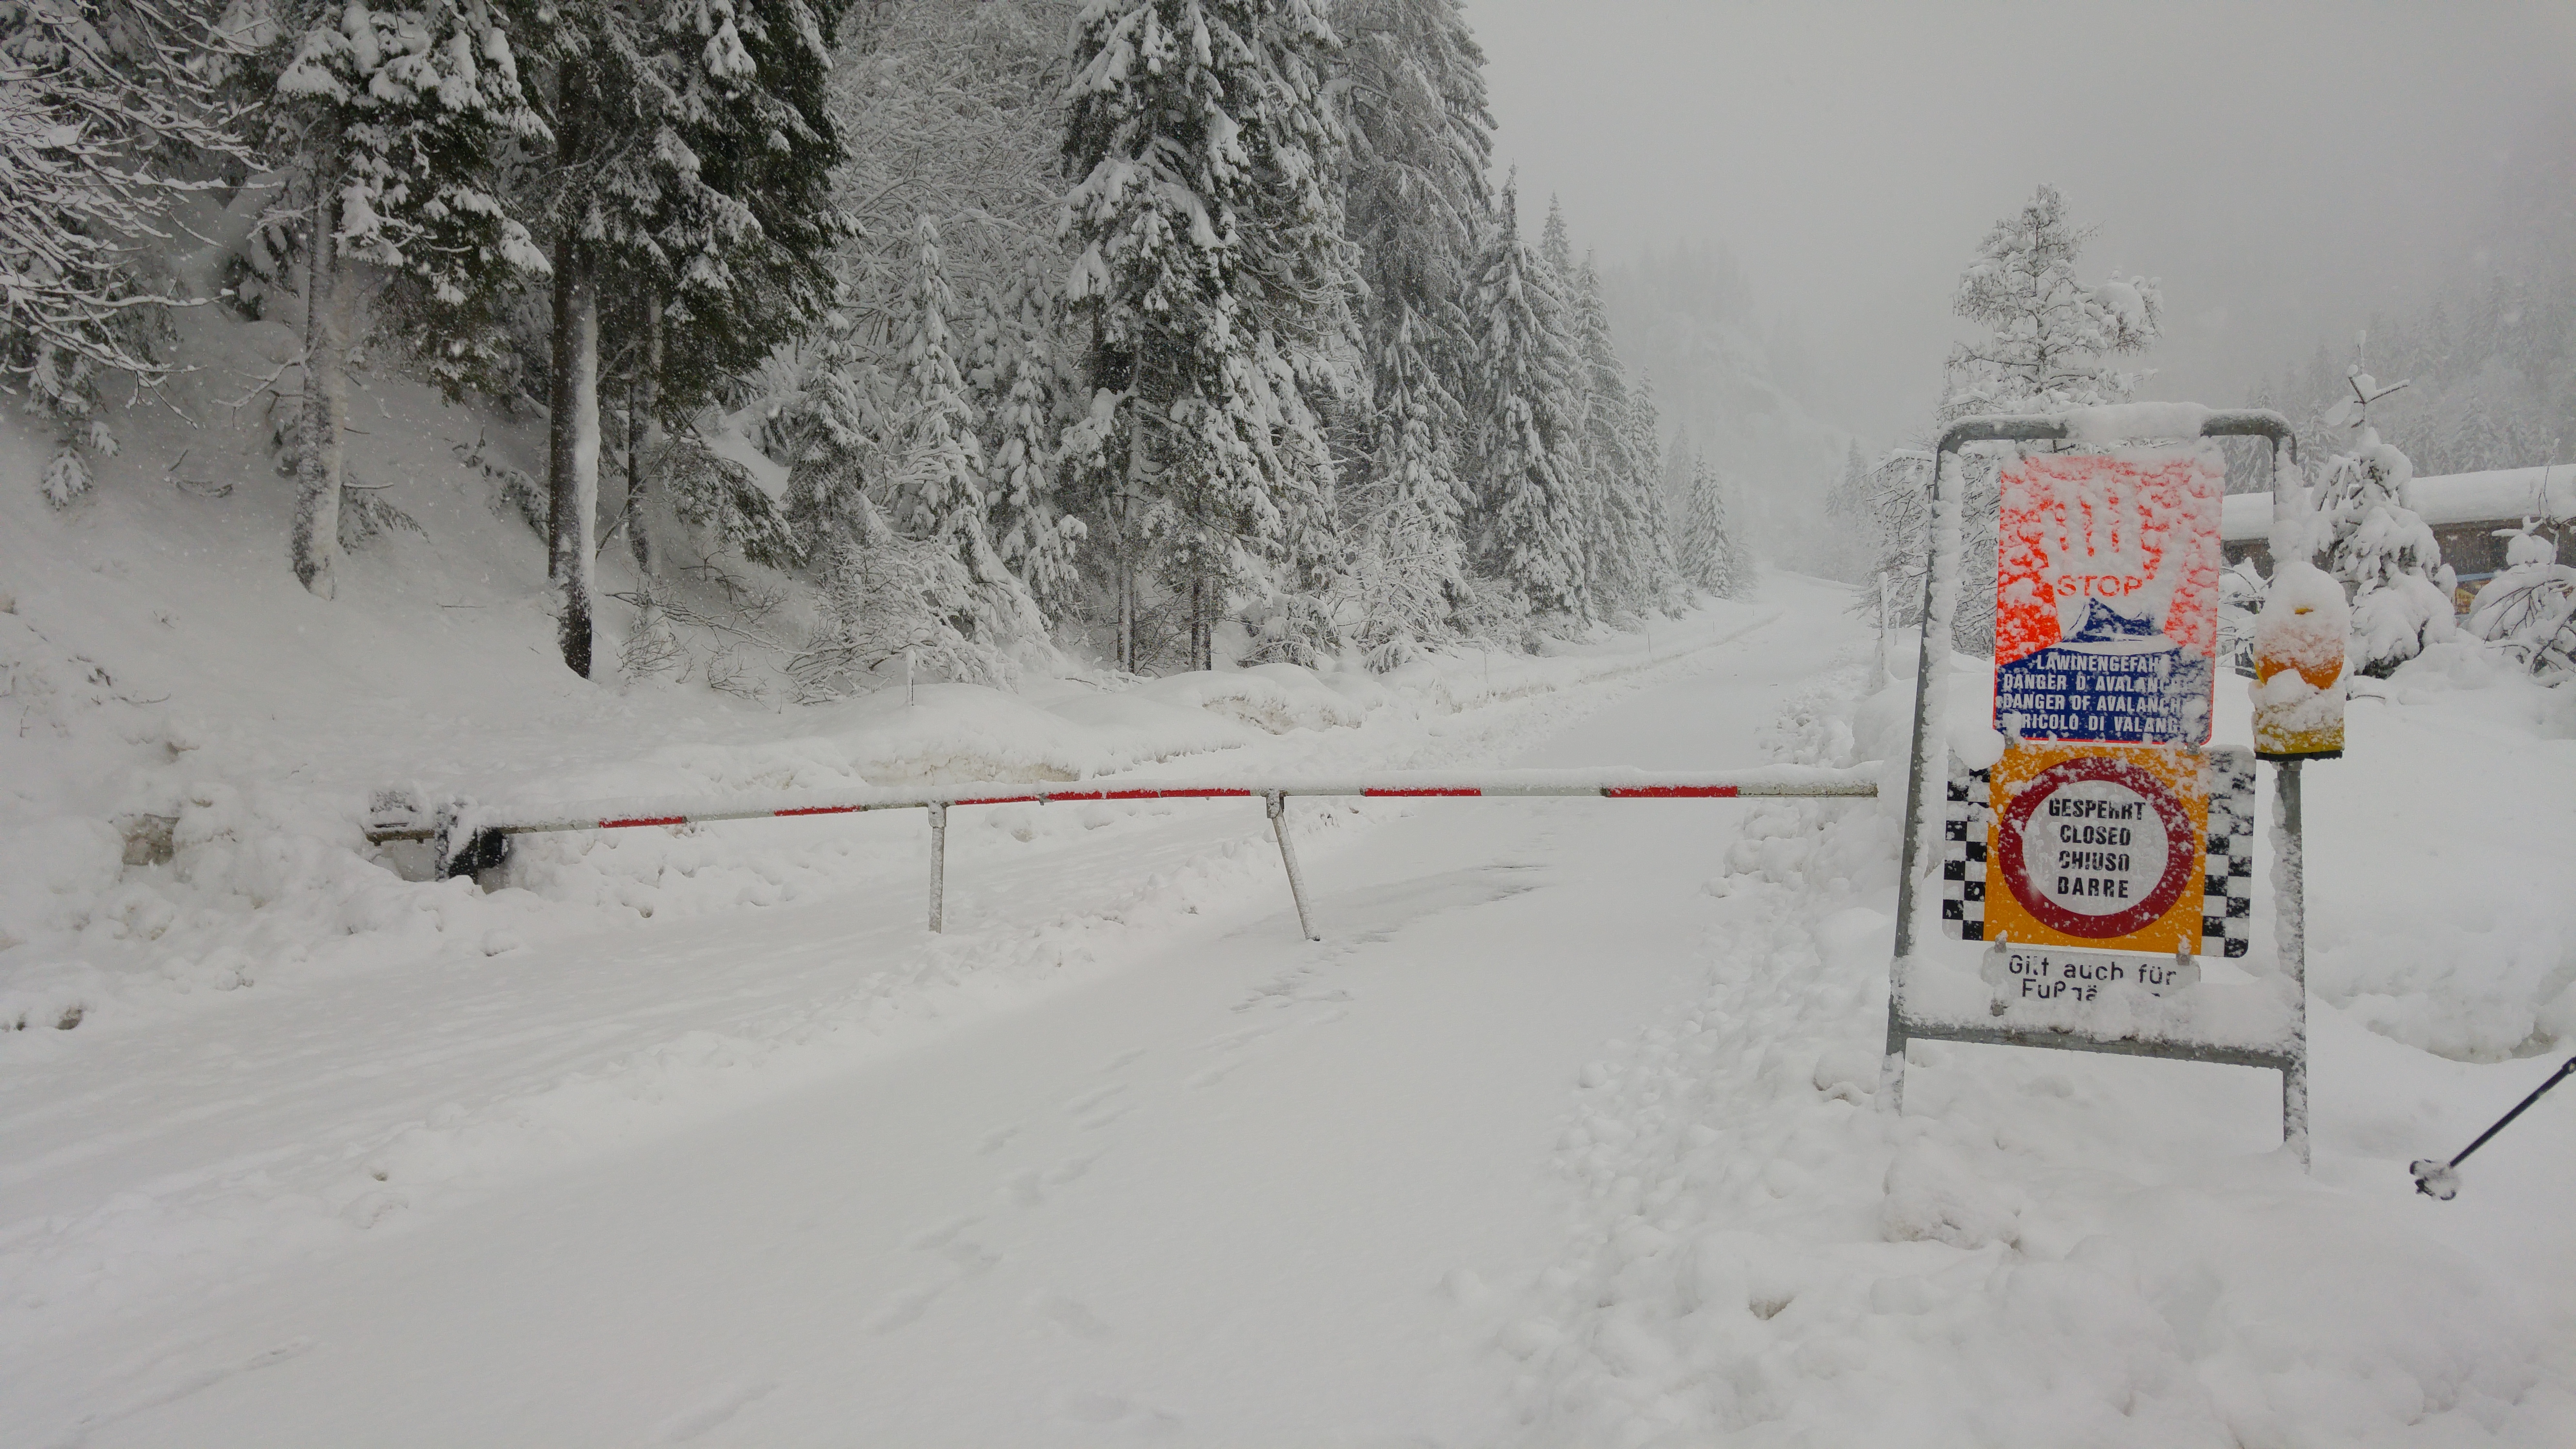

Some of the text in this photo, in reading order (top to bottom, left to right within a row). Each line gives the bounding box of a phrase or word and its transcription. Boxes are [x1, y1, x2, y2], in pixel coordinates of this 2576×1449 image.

[2056, 575, 2143, 597] STOP
[2037, 655, 2167, 673] LAWINENGEFAH
[2003, 674, 2067, 691] DANGER
[2002, 693, 2065, 710] DANGER
[2072, 695, 2091, 711] OF
[2003, 713, 2183, 733] RICOLO DI VALANG
[2049, 798, 2146, 820] GESPERRT
[2061, 824, 2131, 846] CLOSED
[2059, 850, 2130, 871] CHIUSO
[2058, 876, 2129, 898] BARRE
[2063, 962, 2124, 981] auch
[2139, 964, 2177, 985] für
